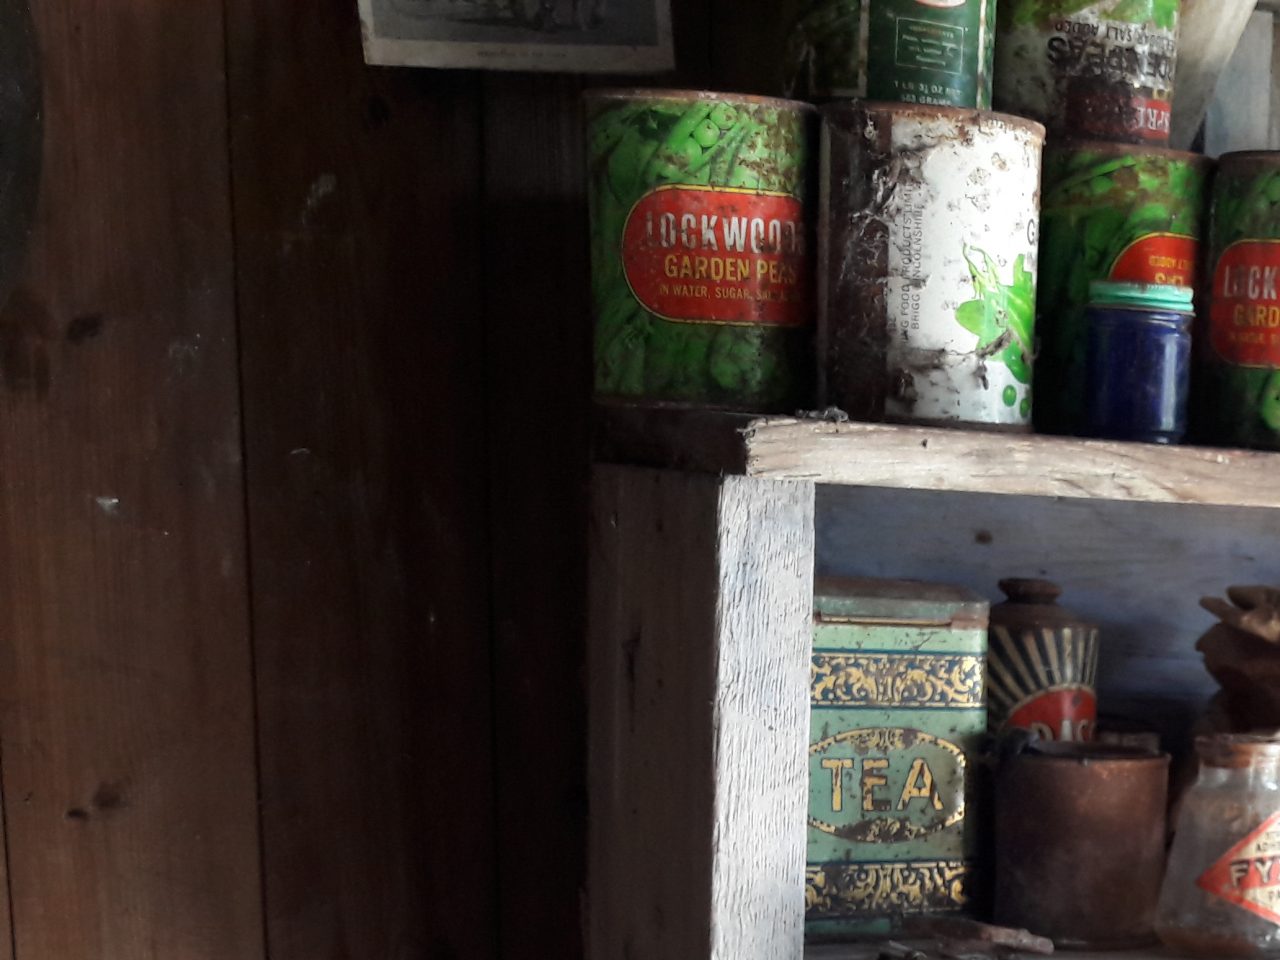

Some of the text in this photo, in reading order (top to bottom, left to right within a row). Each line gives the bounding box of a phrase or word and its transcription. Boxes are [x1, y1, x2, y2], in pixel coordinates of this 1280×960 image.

[911, 203, 924, 284] INCOLNSHIE
[664, 255, 797, 285] GARDEN PEAS
[900, 285, 911, 317] FOOD
[821, 757, 944, 812] TEA
